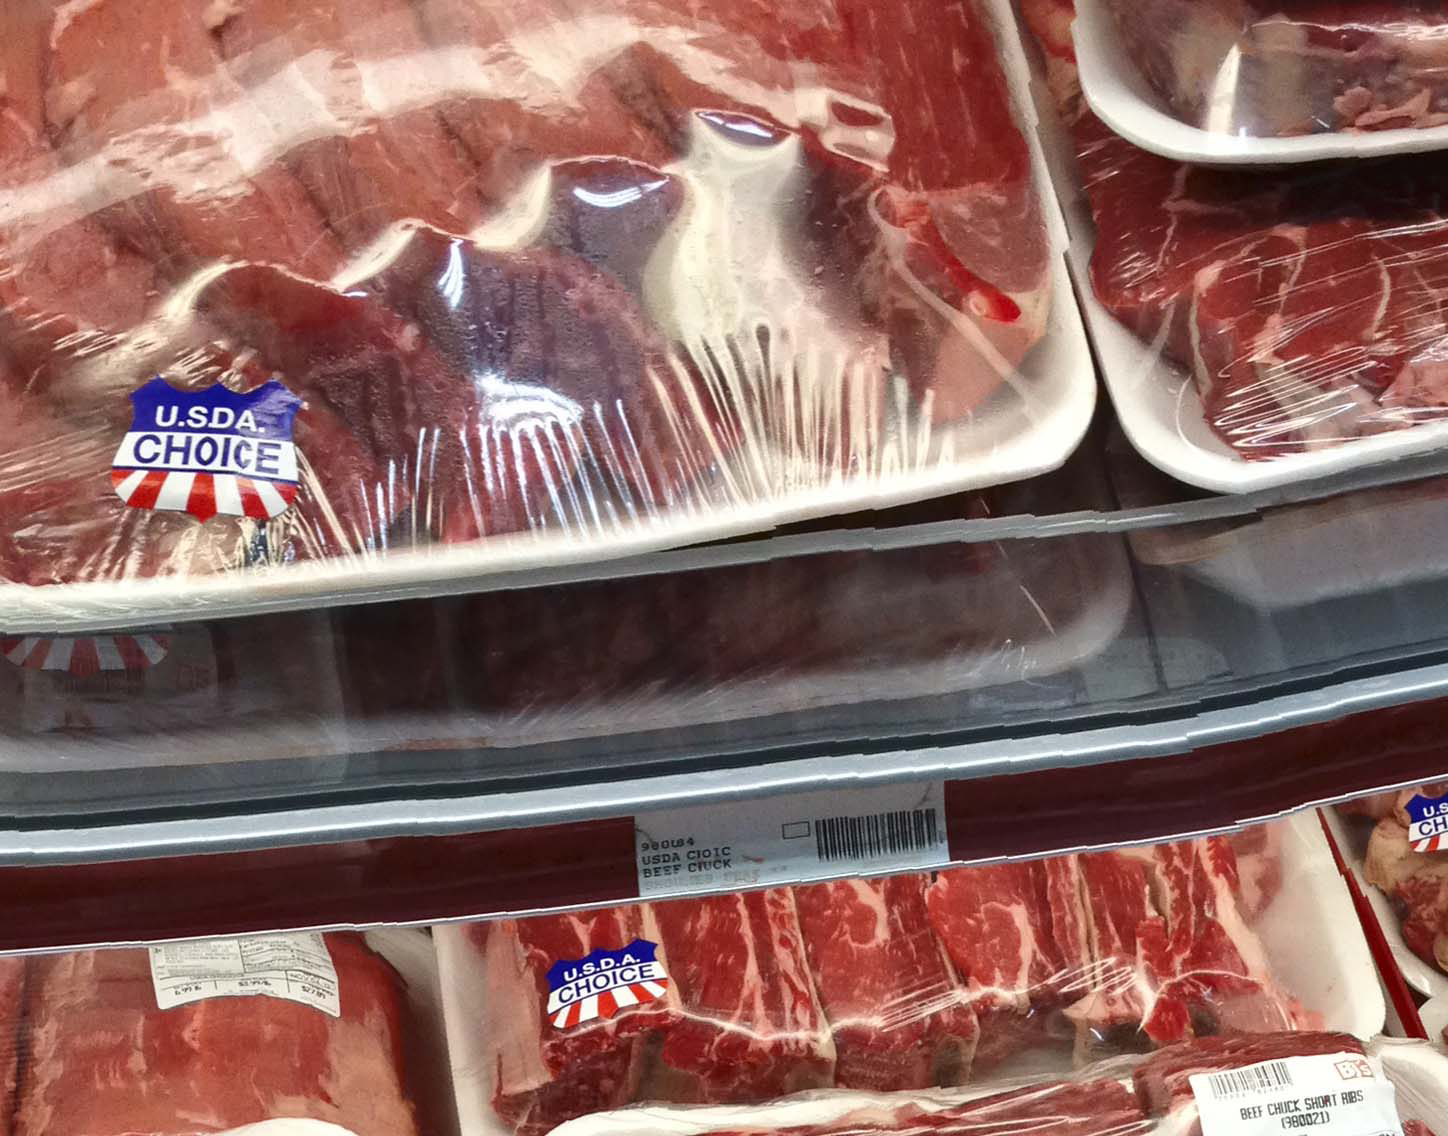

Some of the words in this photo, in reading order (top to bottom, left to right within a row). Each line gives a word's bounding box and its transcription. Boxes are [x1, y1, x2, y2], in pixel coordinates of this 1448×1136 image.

[133, 434, 282, 475] CHOICE
[642, 854, 681, 866] USDA
[642, 864, 682, 879] BEEF
[564, 953, 640, 981] U.S.D.A.
[559, 963, 655, 1003] CHOICE
[1240, 1105, 1263, 1121] BEEF
[1267, 1099, 1302, 1117] CHUCK
[1304, 1094, 1338, 1111] SHORT
[1341, 1089, 1364, 1104] RIBS
